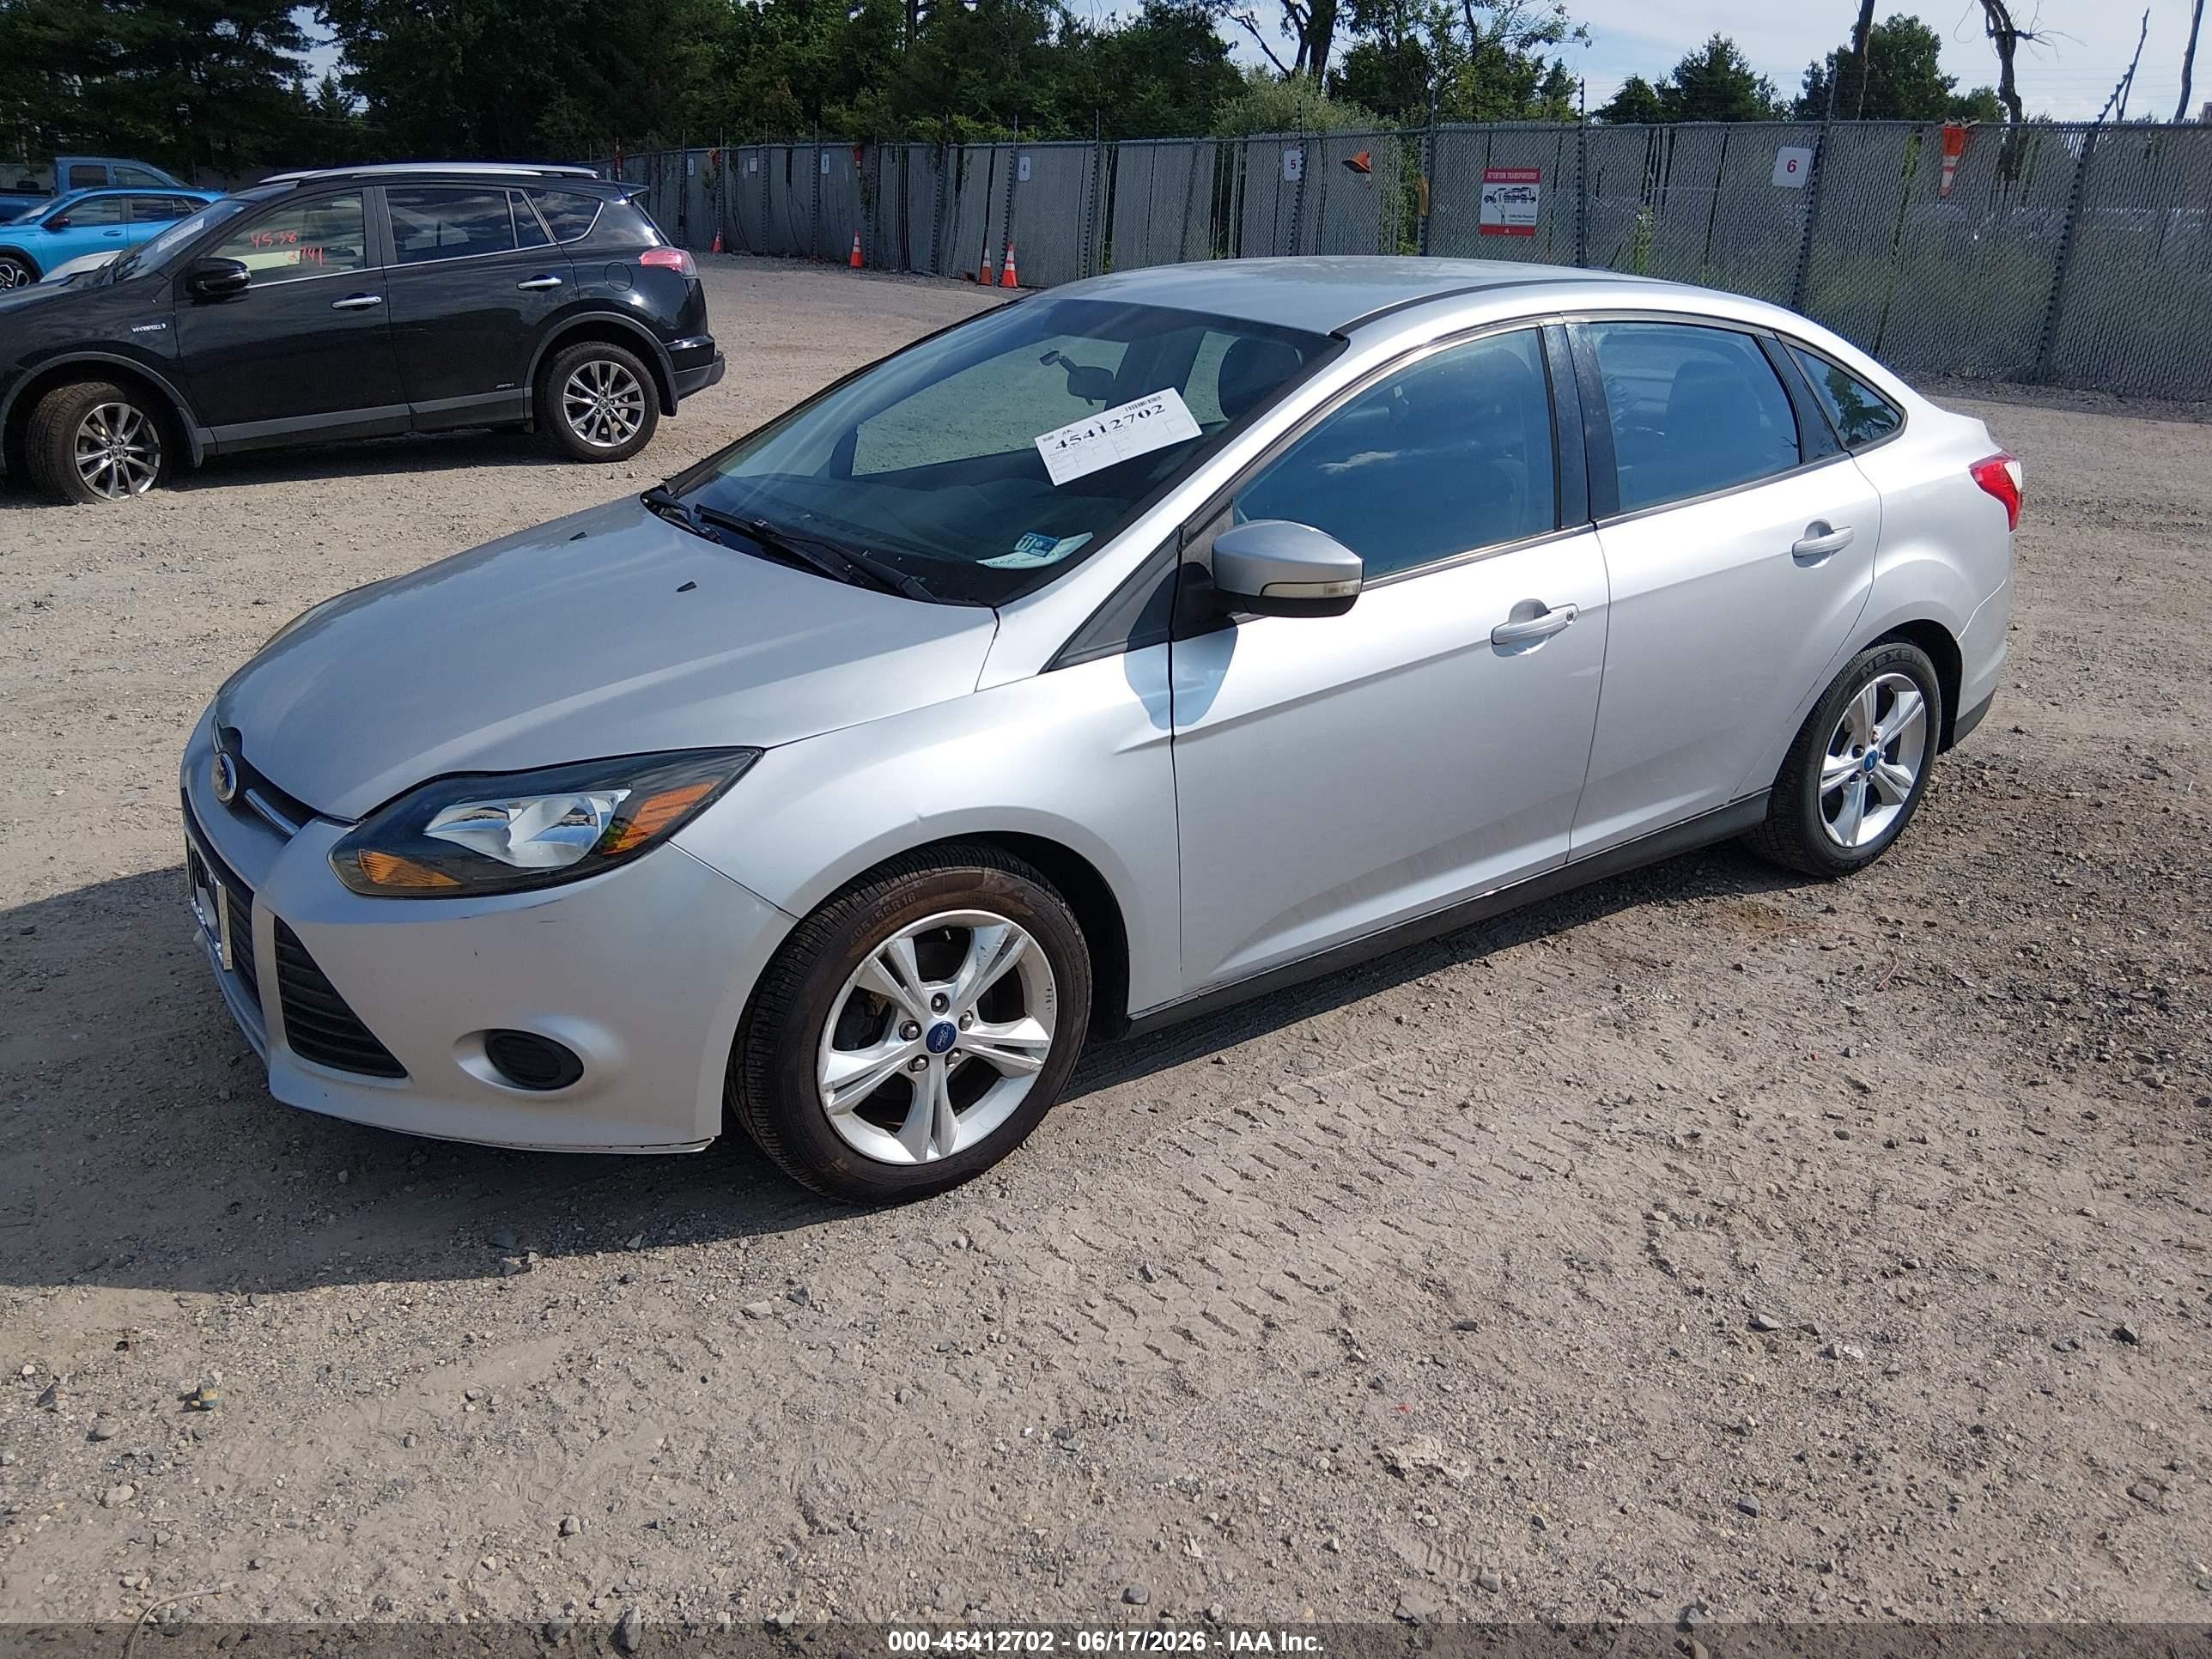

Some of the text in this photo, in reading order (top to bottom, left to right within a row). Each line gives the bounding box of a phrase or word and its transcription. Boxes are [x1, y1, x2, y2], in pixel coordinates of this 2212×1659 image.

[1290, 159, 1297, 170] 5
[1787, 159, 1797, 173] 6
[1054, 404, 1166, 450] 45412702
